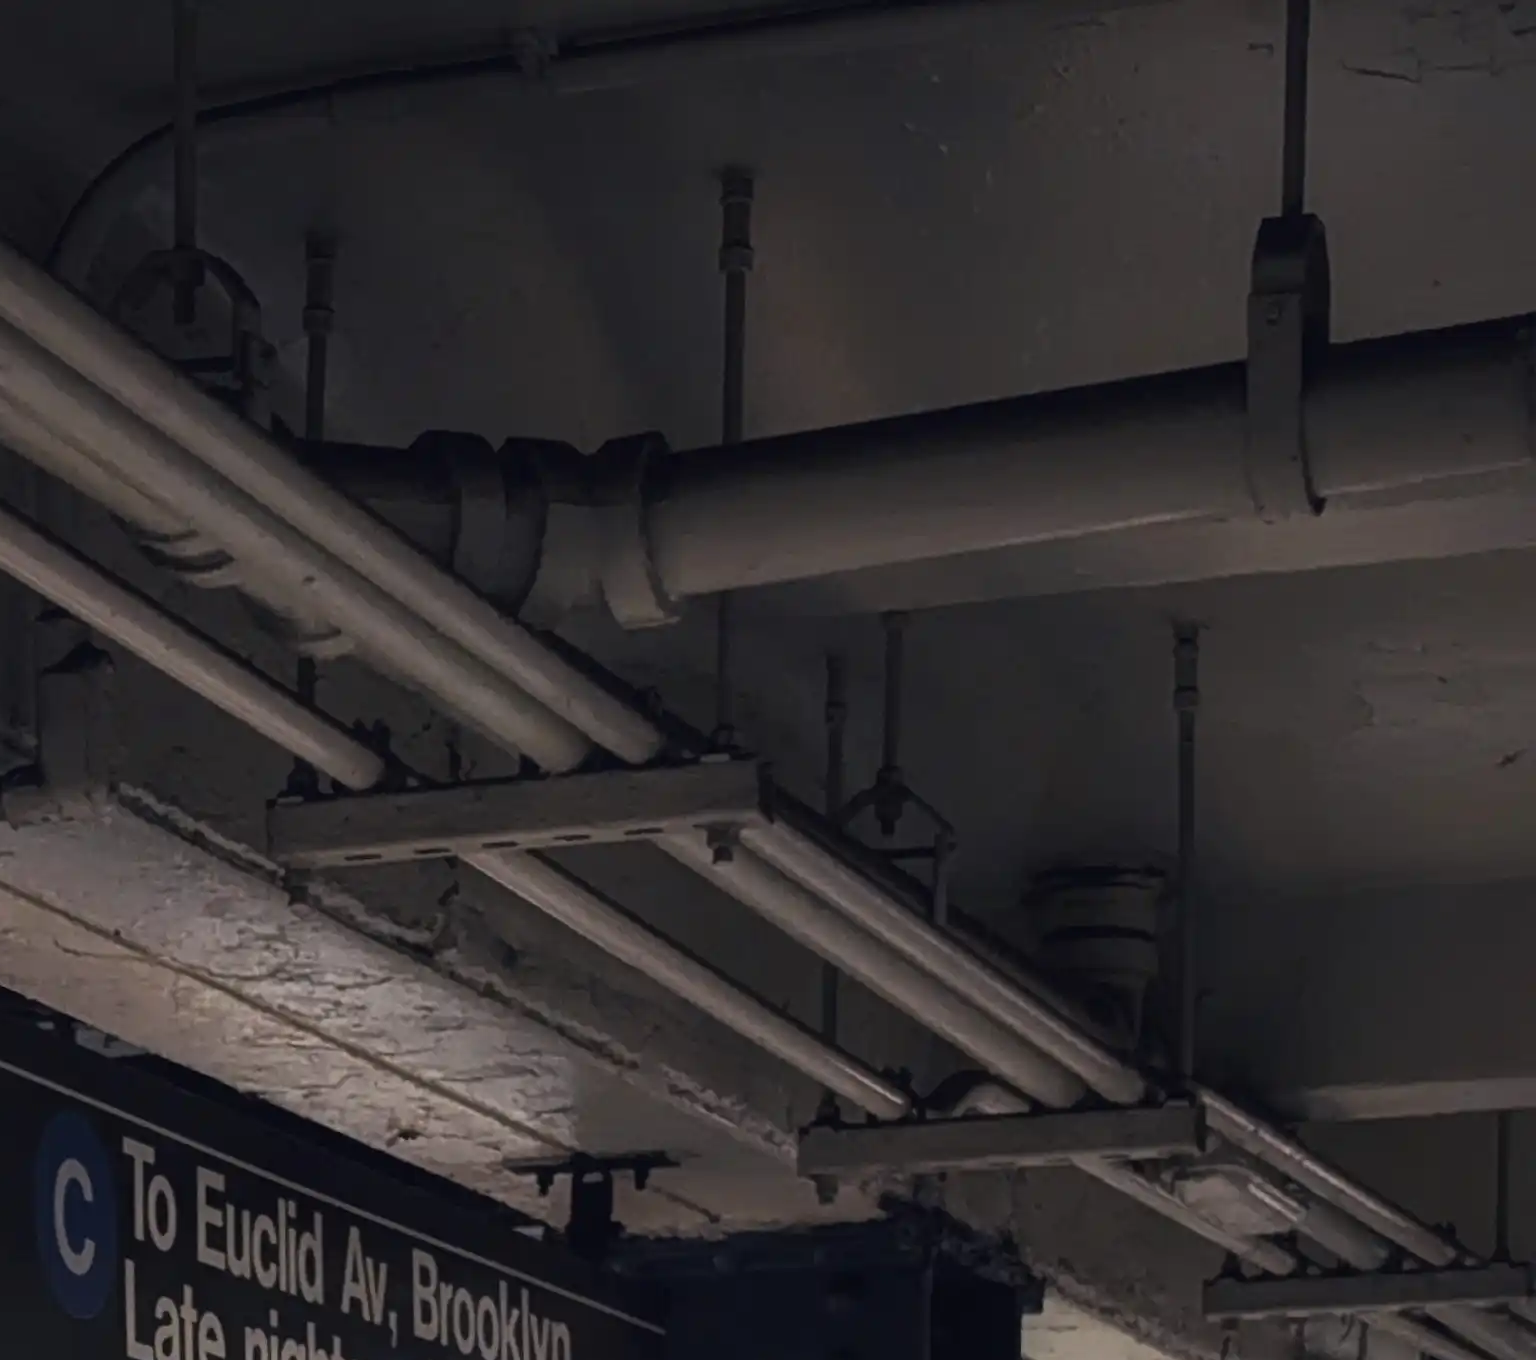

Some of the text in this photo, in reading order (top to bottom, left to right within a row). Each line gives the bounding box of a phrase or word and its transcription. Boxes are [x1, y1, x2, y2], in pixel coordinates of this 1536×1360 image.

[52, 1157, 97, 1276] C
[121, 1135, 178, 1252] To
[196, 1164, 325, 1306] Euclid
[340, 1225, 399, 1348] Av,
